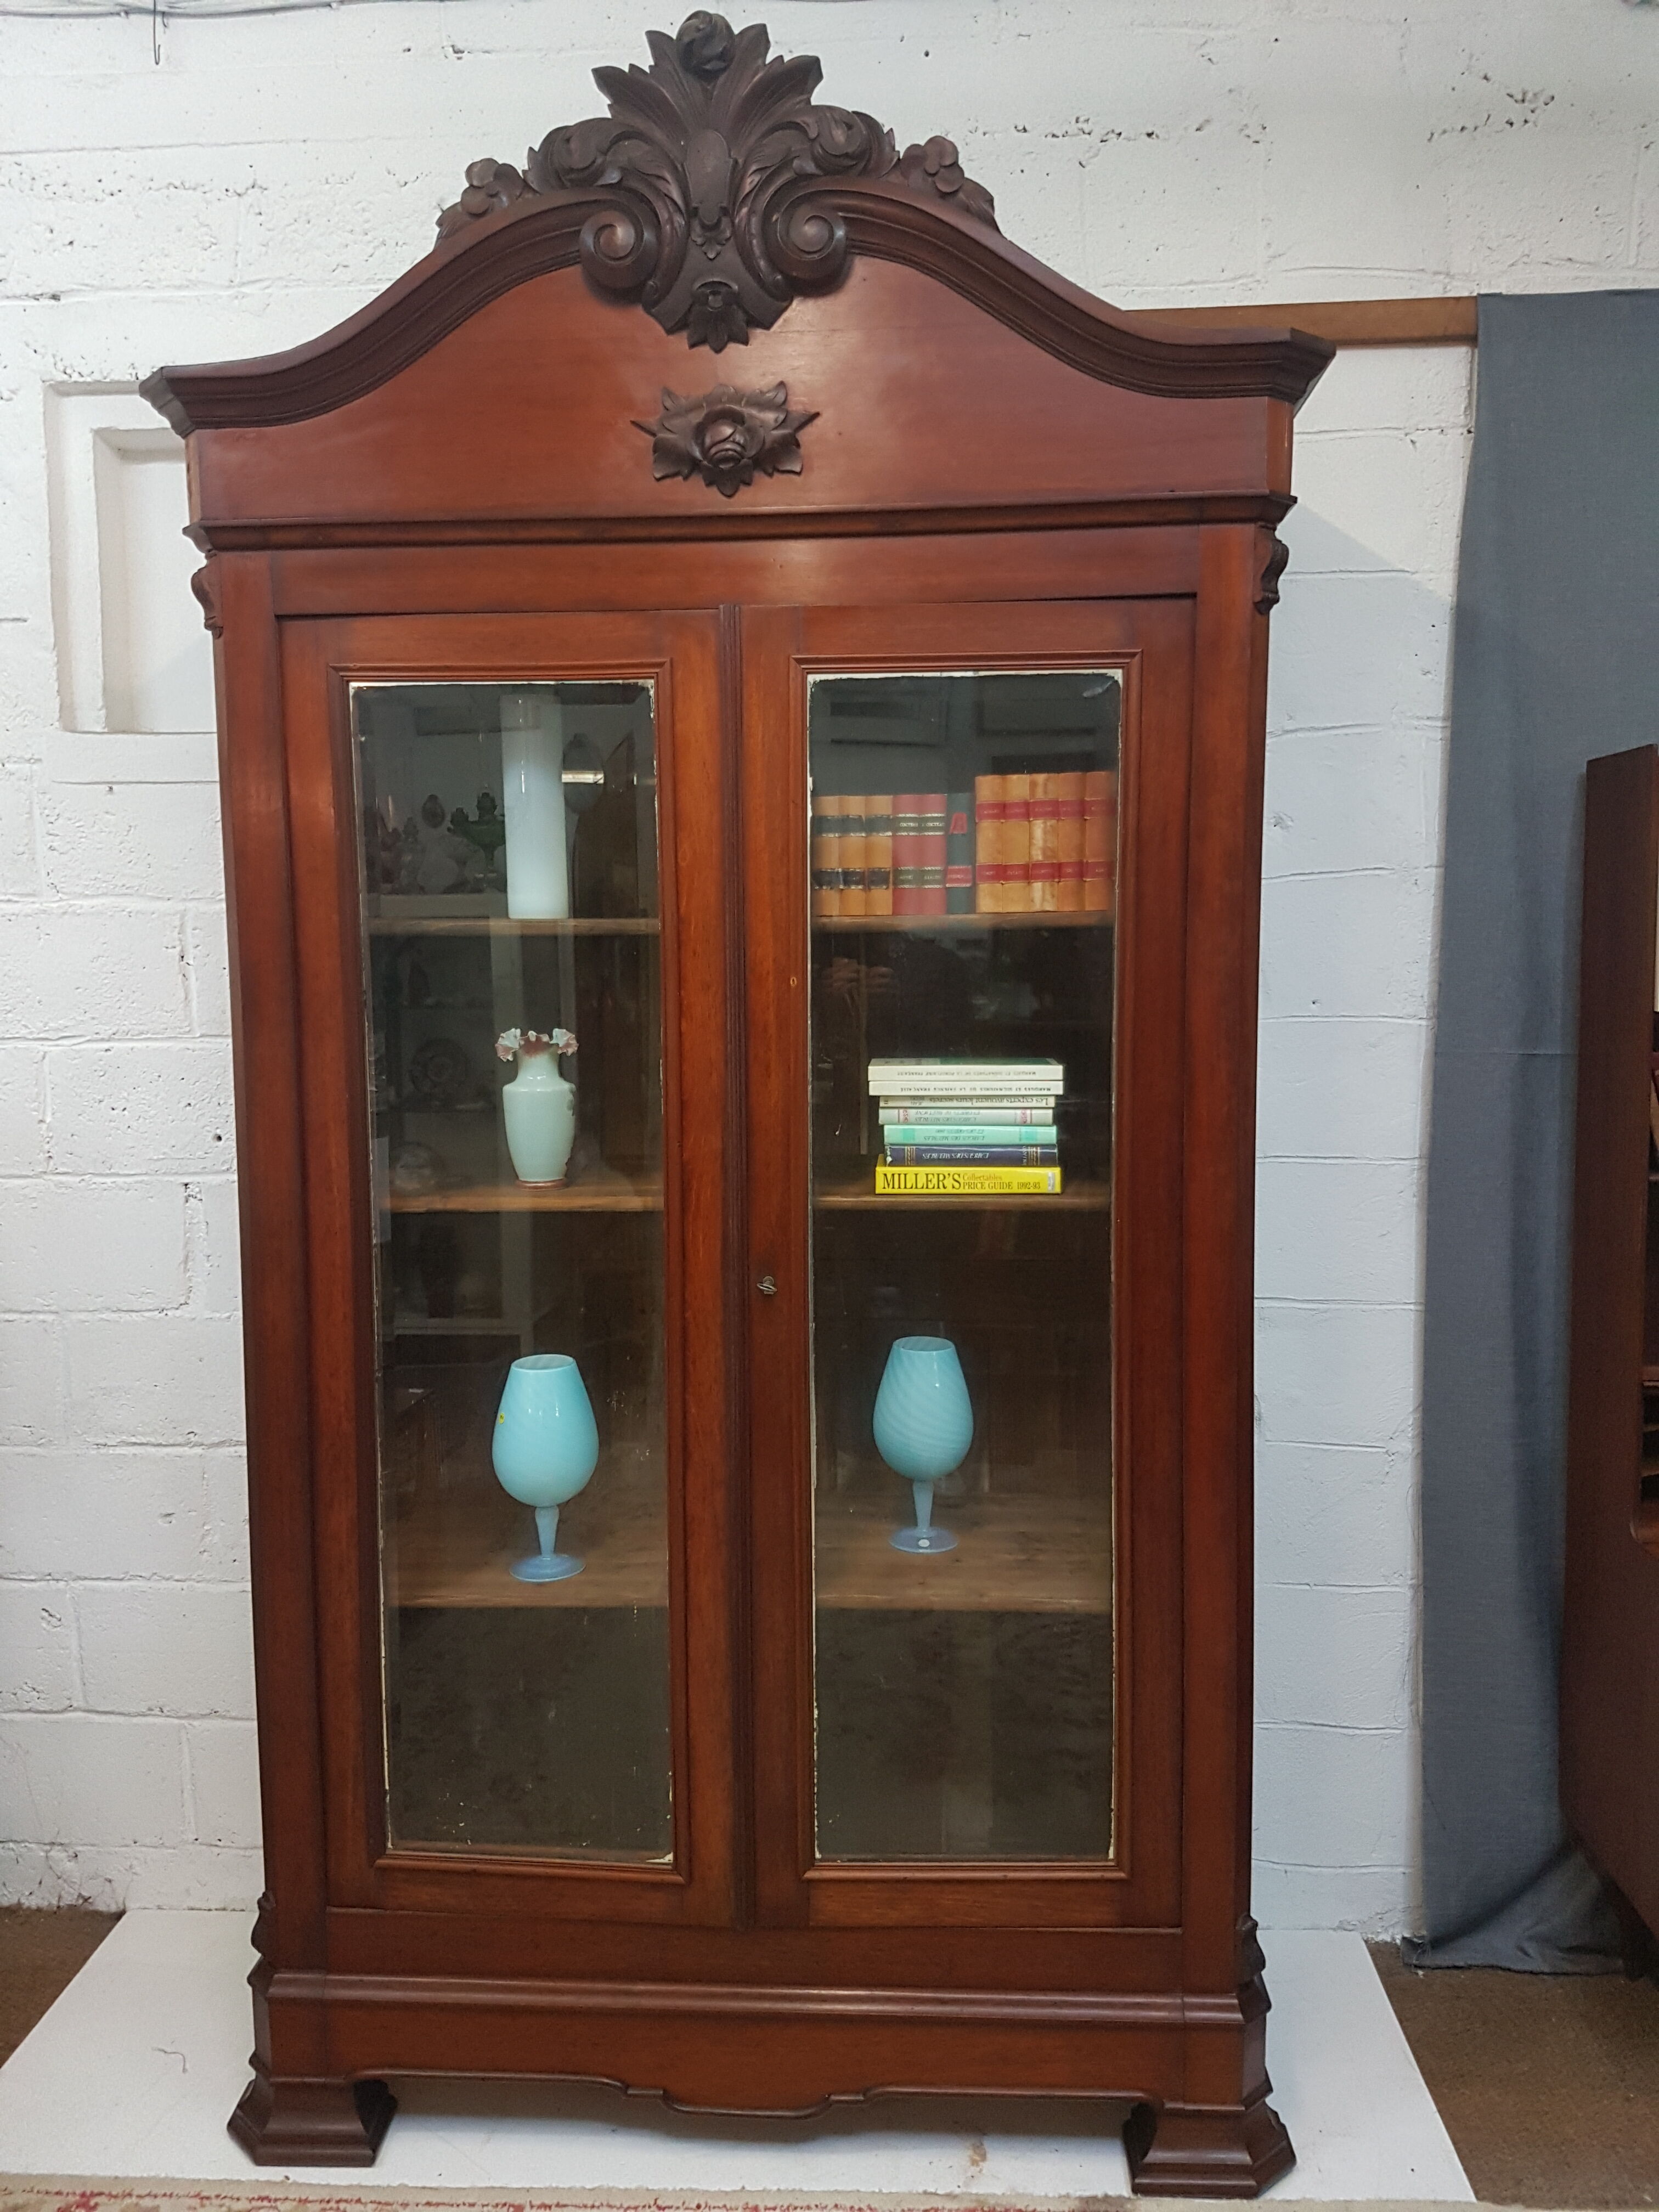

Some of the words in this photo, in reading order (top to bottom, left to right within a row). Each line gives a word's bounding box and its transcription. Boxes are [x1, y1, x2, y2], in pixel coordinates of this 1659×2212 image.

[955, 1097, 973, 1105] leurs
[1006, 1094, 1034, 1104] experts
[962, 1173, 1002, 1181] Collectables
[882, 1173, 961, 1190] MILLER'S
[963, 1182, 986, 1190] PRICE
[988, 1182, 1013, 1190] GUIDE
